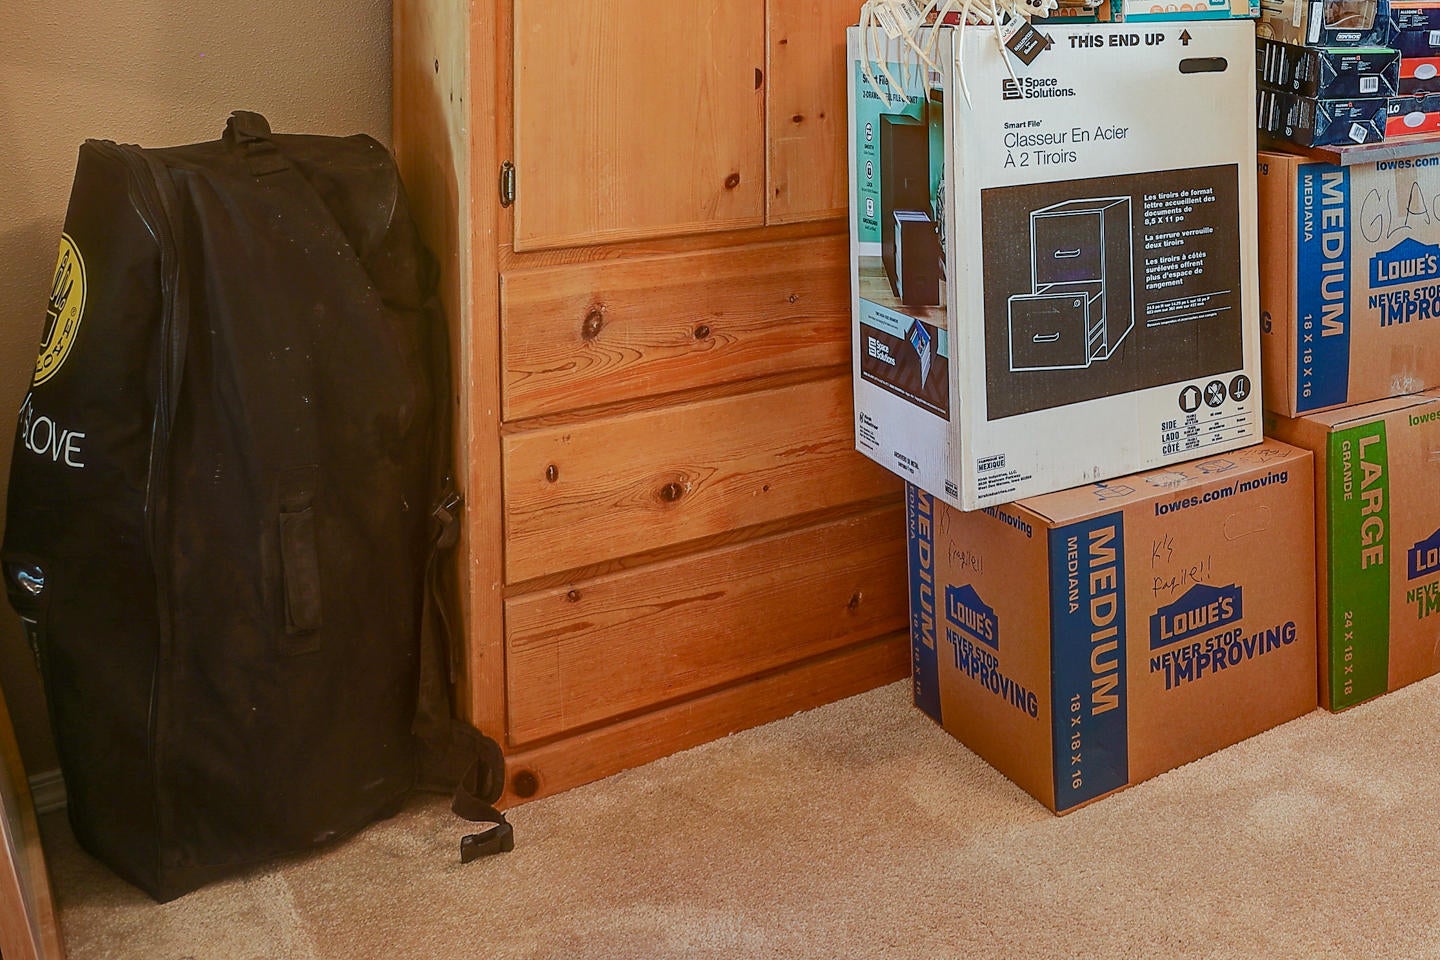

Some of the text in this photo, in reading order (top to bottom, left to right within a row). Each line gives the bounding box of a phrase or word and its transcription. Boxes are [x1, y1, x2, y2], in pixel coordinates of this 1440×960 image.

[1068, 33, 1165, 48] THIS END UP
[1025, 77, 1058, 89] Space
[1004, 121, 1026, 129] Smart
[1003, 125, 1129, 148] Classeur En Acier
[1003, 149, 1077, 169] À 2 Tiroirs
[1144, 187, 1213, 201] Les tiroirs de format
[1144, 195, 1216, 209] lettre accueillent des
[1144, 208, 1182, 217] documents
[1304, 174, 1313, 242] MEDIANA
[1175, 215, 1184, 223] po
[1145, 227, 1214, 242] La serrure verrouille
[1145, 239, 1184, 250] deux tiroirs
[1145, 251, 1207, 265] Les tiroirs à côtés
[1320, 171, 1345, 338] MEDIUM
[1145, 260, 1204, 274] surélevés offrent
[1145, 267, 1203, 283] plus d'espace de
[1377, 254, 1437, 282] LOWE'S
[1145, 279, 1183, 290] rangement
[1368, 291, 1410, 310] NEVER
[1303, 313, 1313, 398] 18 X 18 X 16
[1161, 419, 1177, 431] SIDE
[1161, 431, 1180, 443] LADO
[1162, 442, 1180, 454] CÔTÉ
[978, 460, 1004, 471] MEXIQUE
[1342, 440, 1351, 501] GRANDE
[1154, 470, 1289, 517] lowes.com/moving
[1358, 434, 1384, 571] LARGE
[1067, 535, 1079, 614] MEDIANA
[950, 594, 993, 640] LOWE'S
[1088, 525, 1120, 716] MEDIUM
[1160, 595, 1234, 641] LOWE'S
[946, 627, 998, 670] NEVER STOP
[1150, 627, 1243, 673] NEVER STOP
[1343, 611, 1353, 695] 24 X 18 X 18
[1069, 693, 1082, 789] 18 X 18 X 16
